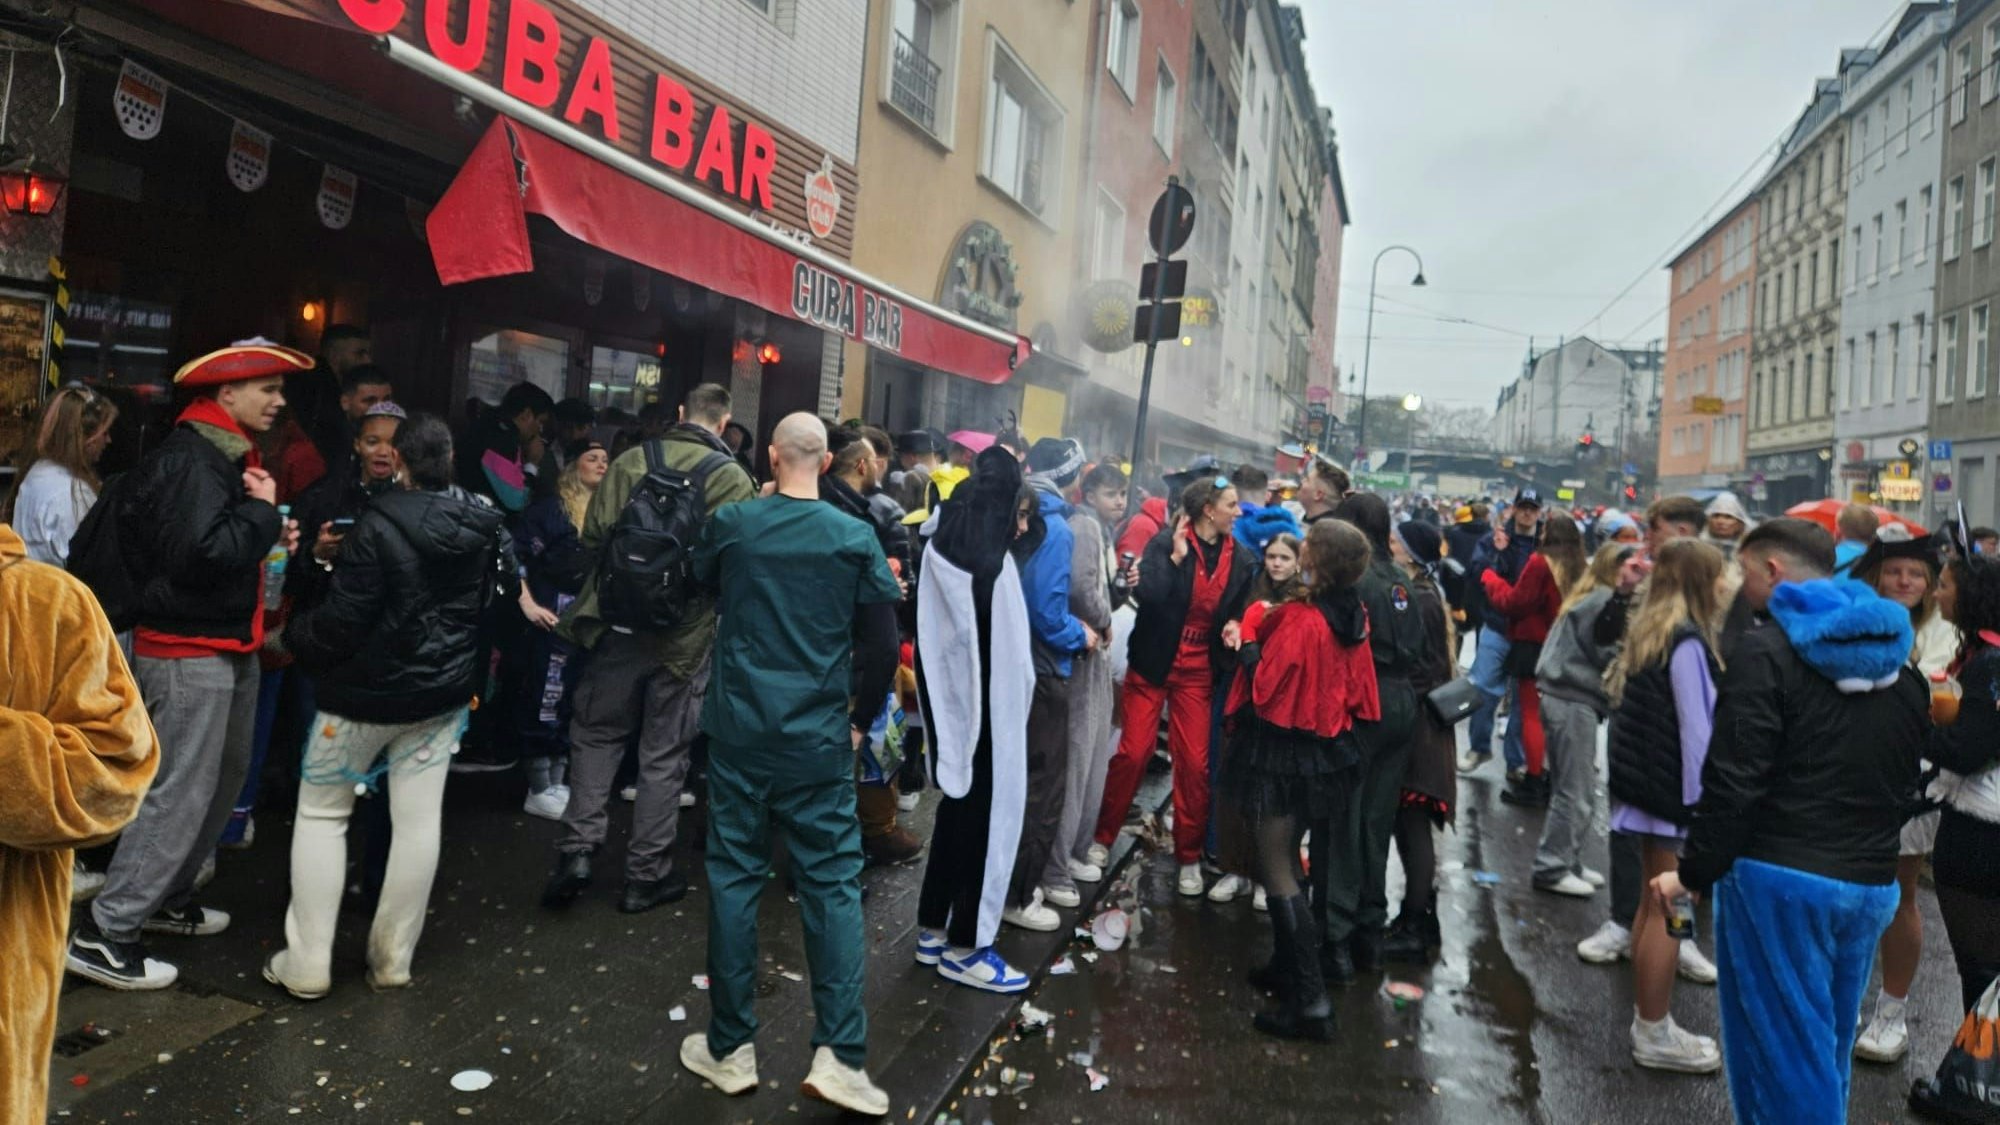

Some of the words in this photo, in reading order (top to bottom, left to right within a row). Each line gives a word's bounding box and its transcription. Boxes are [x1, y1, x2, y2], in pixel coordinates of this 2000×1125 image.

[650, 73, 776, 210] BAR
[792, 260, 855, 336] CUBA
[862, 289, 903, 352] BAR
[1182, 296, 1216, 312] OUL
